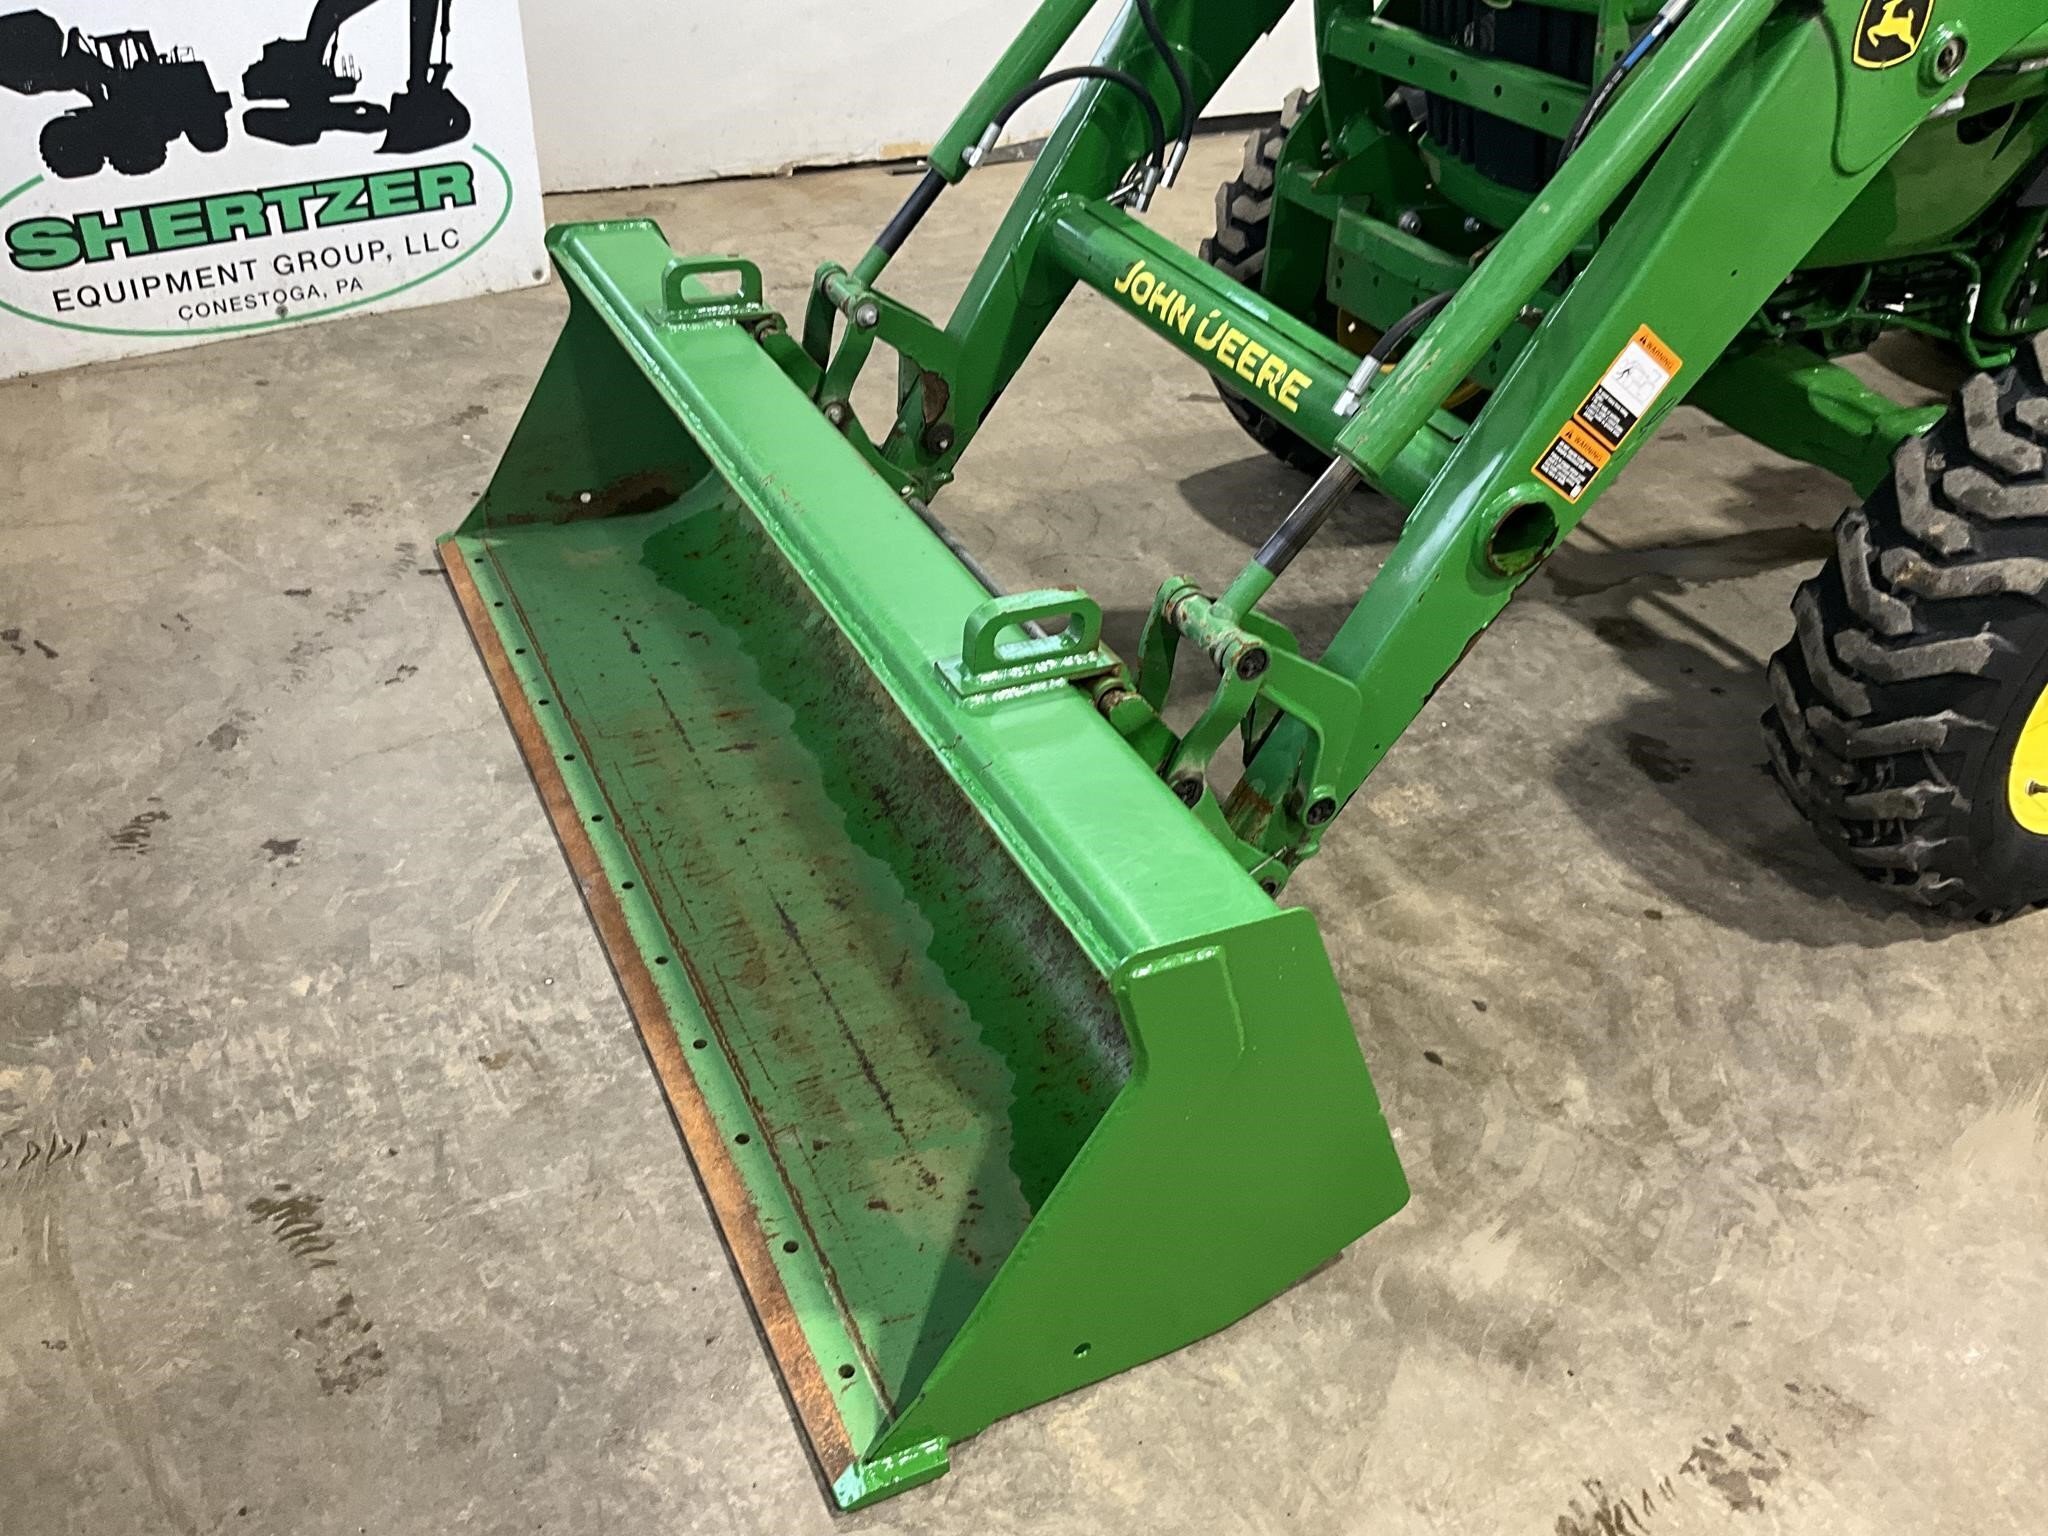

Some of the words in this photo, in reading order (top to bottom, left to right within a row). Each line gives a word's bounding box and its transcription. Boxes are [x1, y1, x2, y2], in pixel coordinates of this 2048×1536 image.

[5, 161, 476, 271] SHERTZER
[52, 259, 257, 312] EQUIPMENT
[273, 240, 392, 276] GROUP,
[406, 228, 461, 255] LLC
[178, 285, 327, 321] CONESTOGA,
[336, 277, 363, 294] PA
[1114, 259, 1196, 335] JOHN
[1194, 309, 1312, 413] DEERE
[1646, 342, 1673, 370] WARNING
[1574, 436, 1603, 462] WARNING
